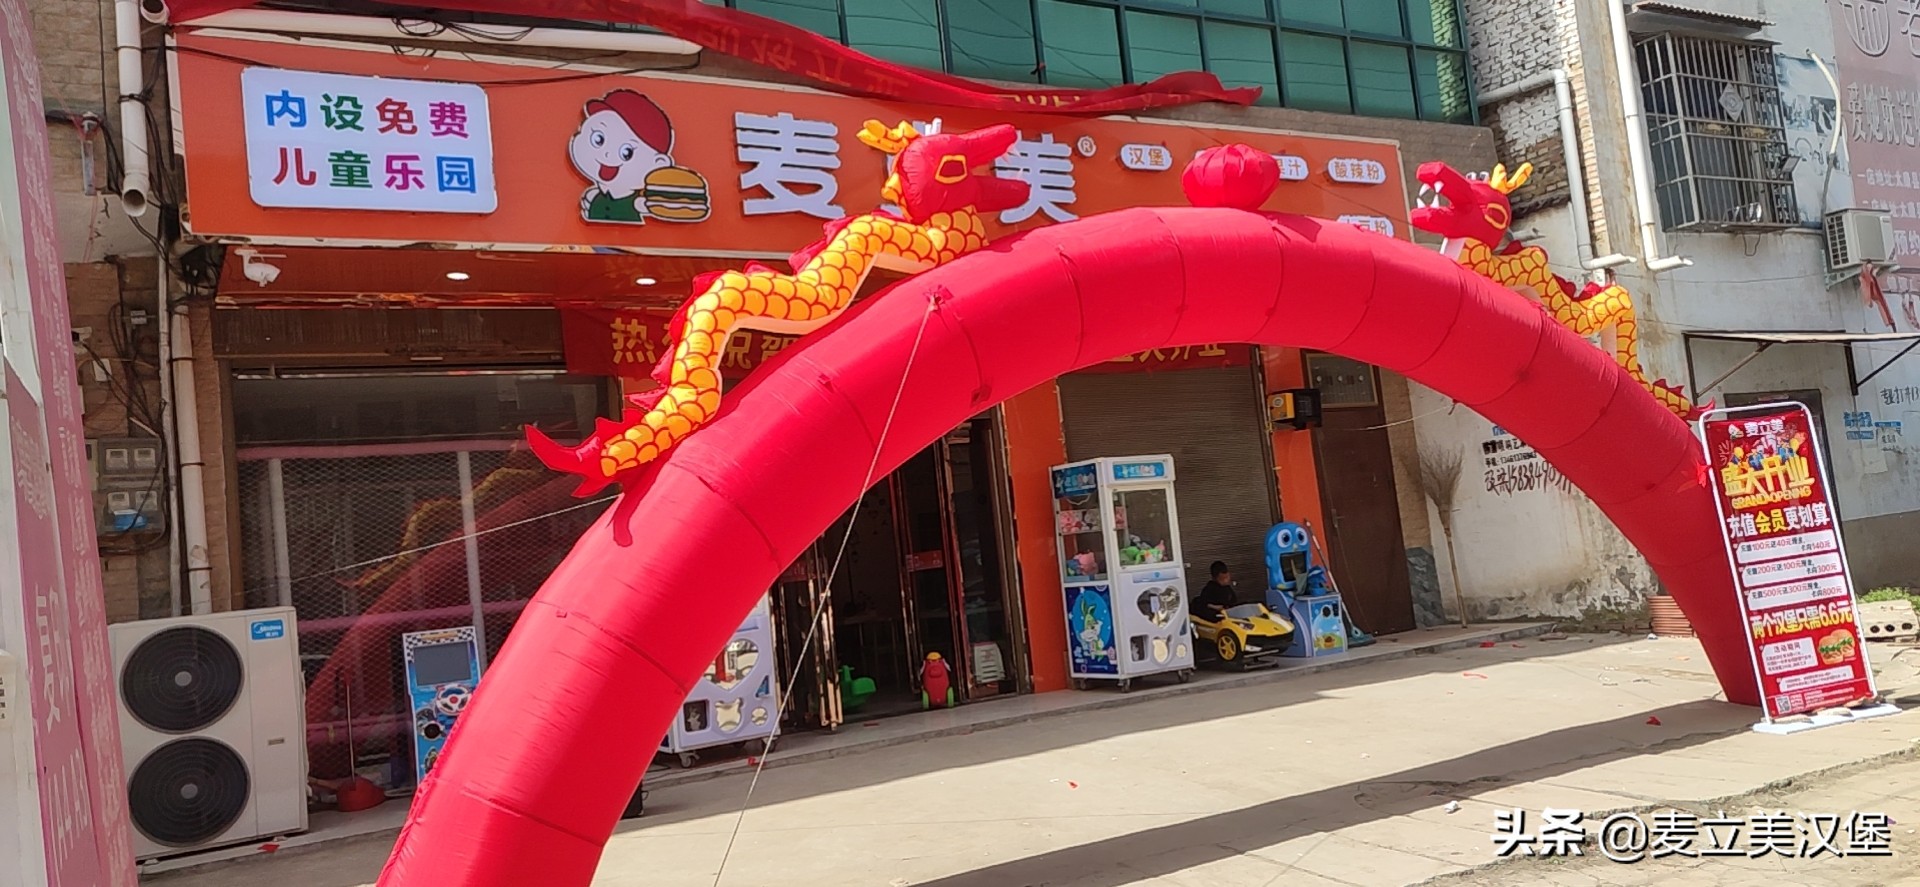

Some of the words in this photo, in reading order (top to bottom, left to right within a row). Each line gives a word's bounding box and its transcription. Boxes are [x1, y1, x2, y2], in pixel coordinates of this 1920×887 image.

[265, 90, 469, 139] 内设免费
[272, 147, 476, 194] 儿童乐园
[734, 112, 1079, 224] 麦美
[1128, 147, 1165, 167] 汉堡
[1333, 161, 1380, 181] 酸辣粉
[1744, 419, 1784, 437] 麦立美
[1721, 455, 1815, 497] 盛大开业
[1769, 485, 1812, 502] OPENING
[1727, 502, 1831, 538] 充值会员更划算
[1749, 600, 1853, 639] 两个汉堡只需6.6元
